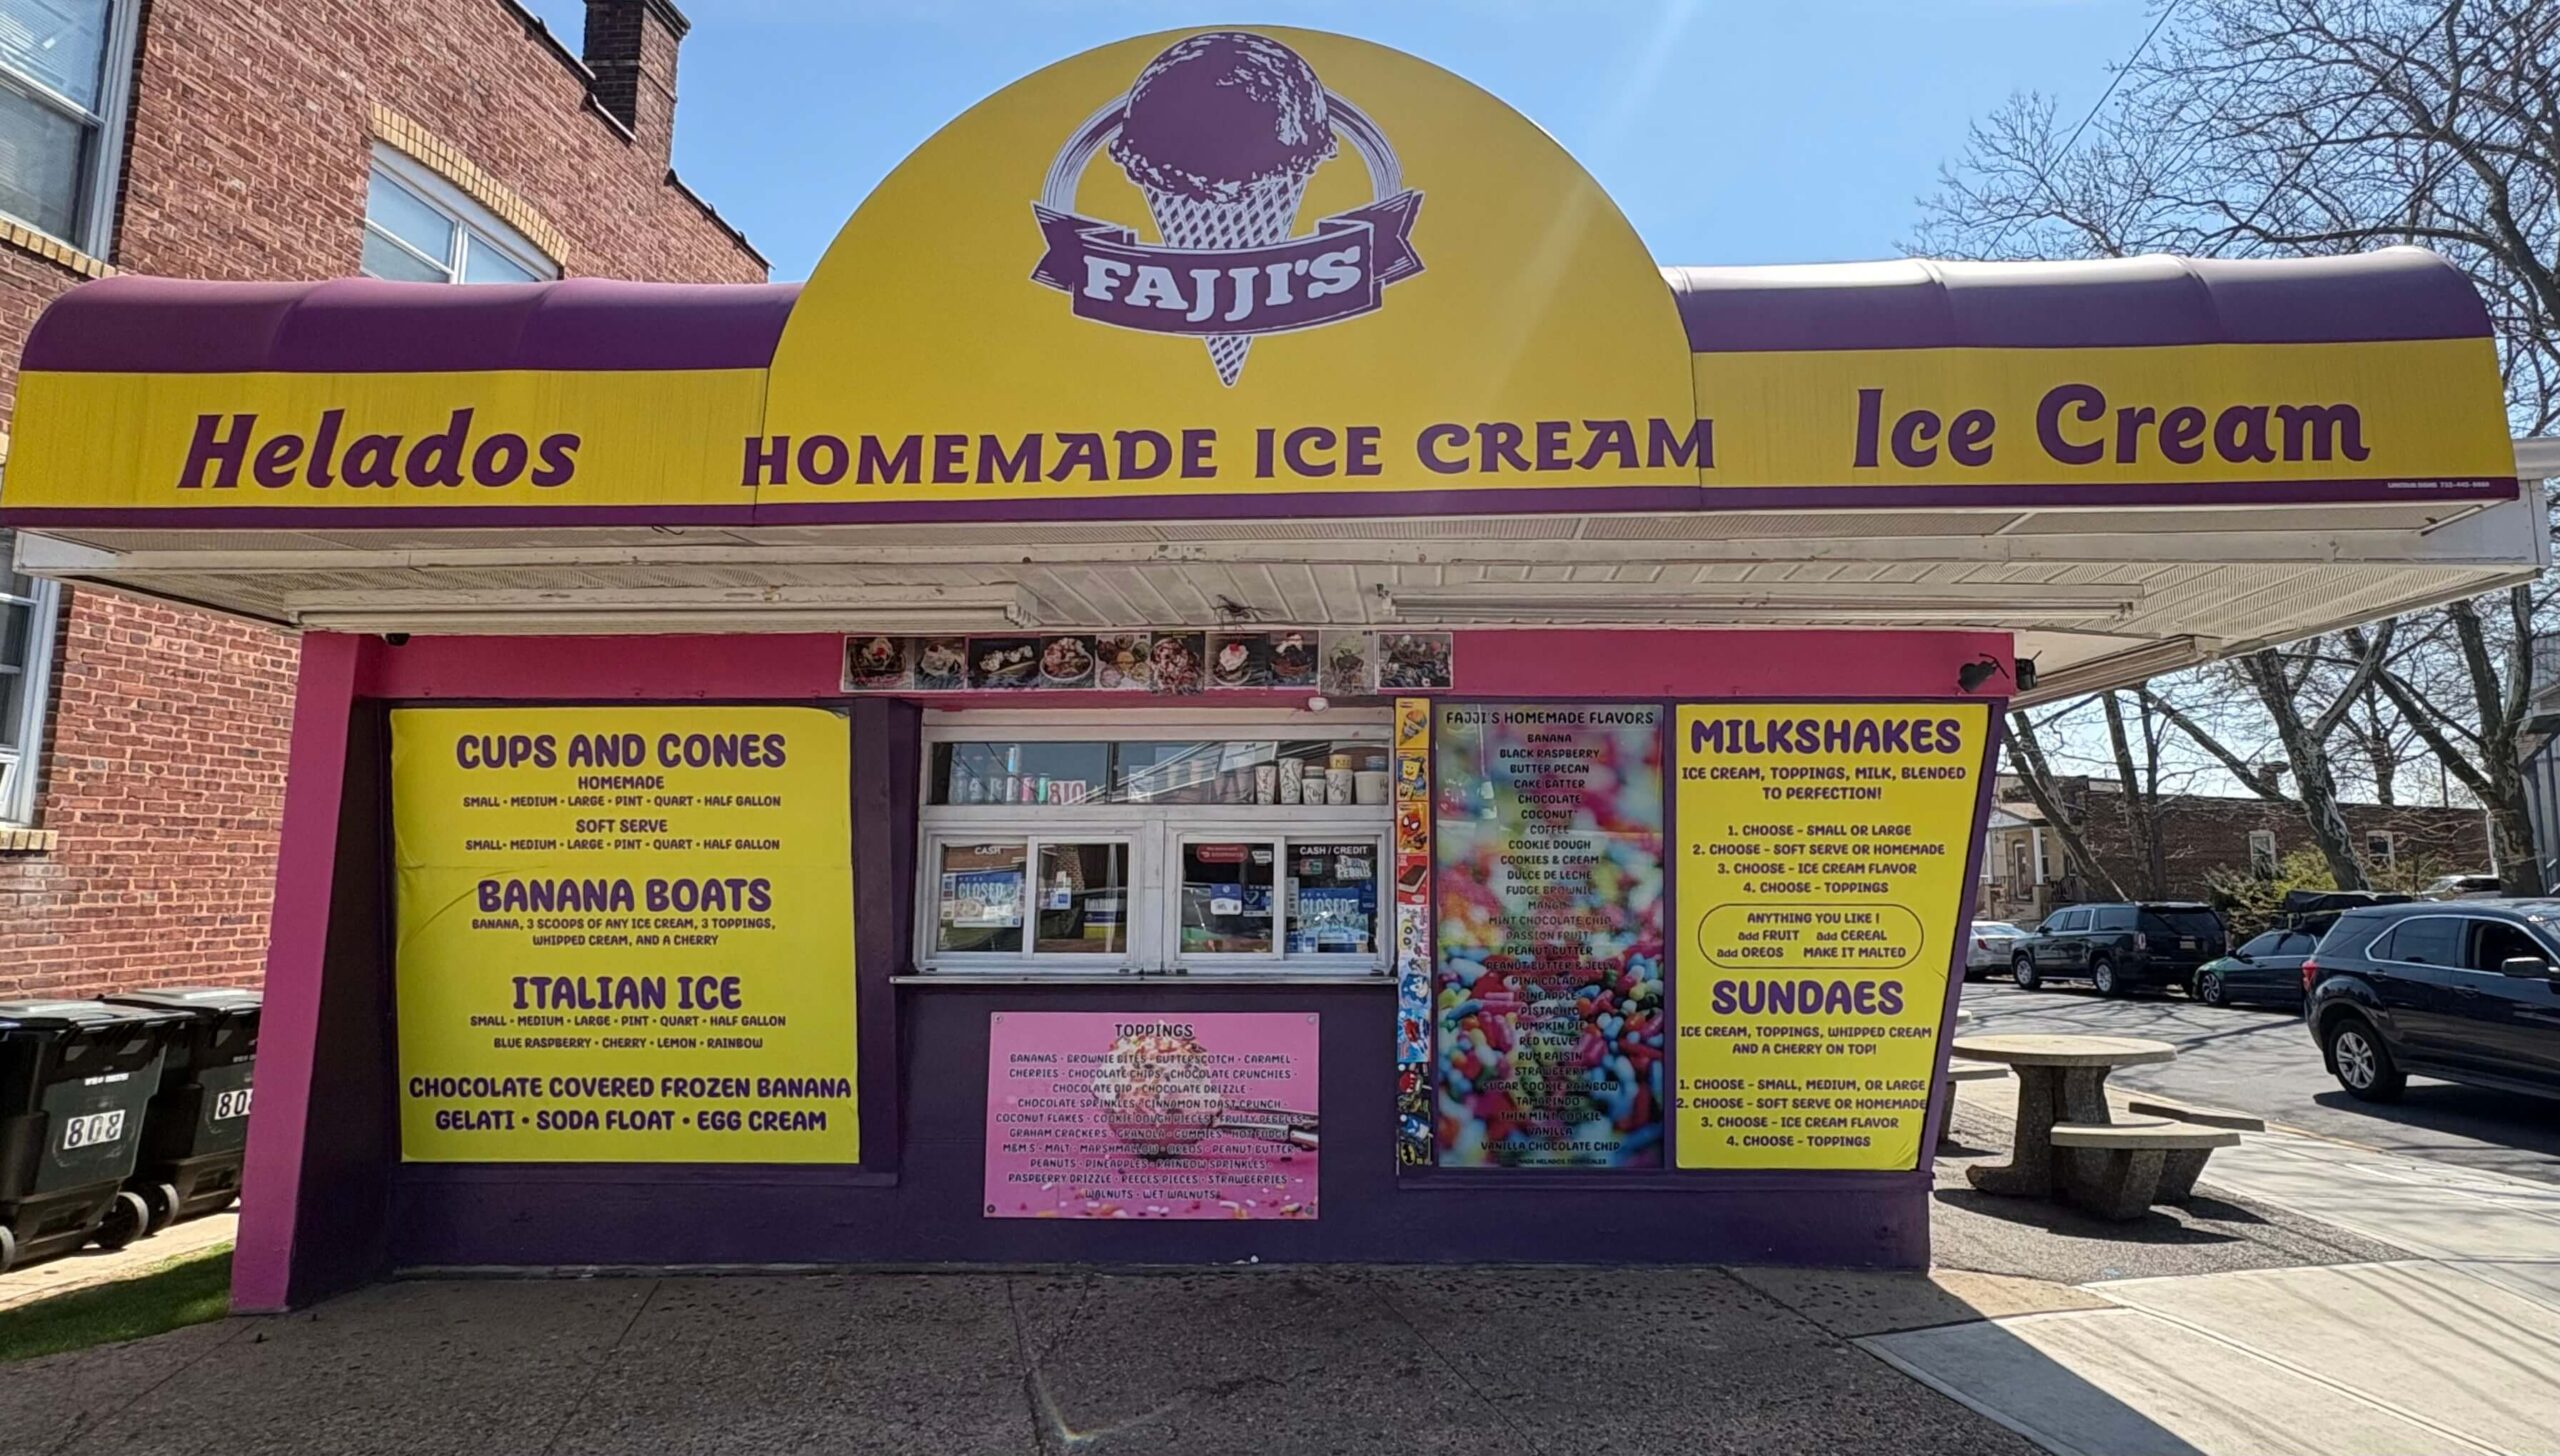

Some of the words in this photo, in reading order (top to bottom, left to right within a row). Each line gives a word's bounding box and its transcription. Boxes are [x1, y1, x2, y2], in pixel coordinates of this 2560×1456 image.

[1083, 246, 1361, 322] FAJJI'S
[1853, 388, 1997, 469] Ice
[2035, 383, 2371, 465] Cream
[177, 407, 582, 488] Helados
[740, 429, 1218, 486] HOMEMADE
[1254, 426, 1383, 478] ICE
[1416, 418, 1716, 474] CREAM
[1446, 712, 1500, 724] FAJJI'S
[1504, 712, 1586, 724] HOMEMADE
[1589, 712, 1653, 724] FLAVORS
[1691, 719, 1961, 753] MILKSHAKES
[456, 733, 556, 769] CUPS
[568, 733, 646, 769] AND
[657, 732, 786, 769] CONES
[1500, 749, 1534, 758] BLACK
[1537, 749, 1599, 758] RASPBERRY
[1510, 764, 1550, 773] BUTTER
[1554, 764, 1589, 773] PECAN
[1682, 767, 1706, 779] ICE
[1710, 767, 1765, 781] CREAM,
[1770, 767, 1850, 781] TOPPINGS,
[1855, 767, 1896, 781] MILK,
[1901, 767, 1965, 779] BLENDED
[578, 776, 664, 790] HOMEMADE
[1514, 779, 1541, 788] CAKE
[1544, 779, 1585, 788] BATTER
[1763, 787, 1781, 799] TO
[1786, 787, 1882, 799] PERFECTION!
[463, 796, 499, 807] SMALL
[510, 796, 557, 807] MEDIUM
[568, 796, 605, 807] LARGE
[615, 796, 642, 807] PINT
[653, 796, 693, 807] QUART
[705, 796, 733, 807] HALF
[735, 796, 781, 807] GALLON
[1518, 795, 1581, 804] CHOCOLATE
[576, 819, 615, 833] SOFT
[619, 819, 668, 833] SERVE
[1728, 825, 1738, 836] 1.
[1743, 825, 1794, 836] CHOOSE
[1807, 825, 1846, 836] SMALL
[1851, 825, 1868, 836] OR
[1871, 825, 1911, 836] LARGE
[1508, 840, 1550, 849] COOKIE
[1553, 840, 1591, 849] DOUGH
[1693, 844, 1705, 854] 2.
[1709, 844, 1760, 854] CHOOSE
[1773, 844, 1806, 854] SOFT
[1809, 844, 1848, 854] SERVE
[1852, 844, 1870, 854] OR
[1874, 844, 1944, 854] HOMEMADE
[974, 847, 1001, 855] CASH
[1300, 846, 1327, 855] CASH
[1334, 846, 1368, 855] CREDIT
[1718, 864, 1730, 874] 3.
[1734, 864, 1785, 874] CHOOSE
[1798, 864, 1819, 874] ICE
[1822, 864, 1865, 874] CREAM
[1868, 864, 1917, 874] FLAVOR
[1507, 871, 1540, 880] DULCE
[1544, 871, 1556, 880] DE
[1559, 871, 1592, 880] LECHE
[958, 882, 1003, 899] CLOSED
[1743, 883, 1756, 893] 4.
[1760, 883, 1811, 893] CHOOSE
[1824, 883, 1888, 893] TOPPINGS
[478, 879, 634, 912] BANANA
[646, 878, 771, 912] BOATS
[1301, 898, 1350, 916] CLOSED
[1747, 913, 1812, 924] ANYTHING
[1815, 913, 1840, 924] YOU
[1845, 913, 1872, 924] LIKE
[472, 919, 523, 931] BANANA,
[527, 919, 534, 929] 3
[537, 919, 584, 929] SCOOPS
[587, 919, 602, 929] OF
[605, 919, 628, 929] ANY
[632, 919, 651, 929] ICE
[653, 919, 698, 931] CREAM,
[701, 919, 709, 929] 3
[712, 919, 775, 931] TOPPINGS,
[1738, 931, 1759, 941] add
[1763, 931, 1799, 941] FRUIT
[1816, 931, 1837, 941] add
[1841, 931, 1887, 941] CEREAL
[1717, 948, 1738, 958] add
[1741, 948, 1784, 958] OREOS
[1803, 948, 1838, 958] MAKE
[1842, 948, 1855, 958] IT
[1859, 948, 1906, 958] MALTED
[512, 976, 666, 1009] ITALIAN
[678, 976, 741, 1009] ICE
[1712, 980, 1904, 1015] SUNDAES
[470, 1016, 507, 1027] SMALL
[517, 1016, 564, 1027] MEDIUM
[574, 1016, 610, 1027] LARGE
[621, 1016, 648, 1027] PINT
[660, 1016, 699, 1027] QUART
[710, 1016, 738, 1027] HALF
[741, 1016, 786, 1027] GALLON
[1115, 1024, 1193, 1037] TOPPINGS
[1681, 1026, 1701, 1038] ICE
[1704, 1026, 1751, 1039] CREAM,
[1756, 1026, 1823, 1039] TOPPINGS,
[1828, 1026, 1885, 1038] WHIPPED
[1889, 1026, 1931, 1038] CREAM
[494, 1038, 521, 1049] BLUE
[525, 1038, 591, 1049] RASPBERRY
[602, 1038, 646, 1049] CHERRY
[657, 1038, 696, 1049] LEMON
[707, 1038, 763, 1049] RAINBOW
[1733, 1044, 1758, 1054] AND
[1762, 1044, 1770, 1054] A
[1773, 1044, 1822, 1054] CHERRY
[1826, 1044, 1844, 1054] ON
[1848, 1044, 1876, 1054] TOP!
[1010, 1055, 1058, 1064] BANANAS
[1067, 1055, 1114, 1064] BROWNIE
[1117, 1055, 1147, 1064] BITES
[1156, 1055, 1235, 1064] BUTTERSCOTCH
[1244, 1055, 1291, 1064] CARAMEL
[1518, 1052, 1544, 1061] RUM
[1547, 1052, 1582, 1061] RAISIN
[1009, 1069, 1059, 1079] CHERRIES
[1068, 1069, 1128, 1079] CHOCOLATE
[1130, 1069, 1161, 1079] CHIPS
[1170, 1069, 1230, 1079] CHOCOLATE
[1233, 1069, 1291, 1079] CRUNCHIES
[409, 1077, 543, 1098] CHOCOLATE
[549, 1077, 654, 1098] COVERED
[661, 1077, 750, 1098] FROZEN
[757, 1077, 851, 1098] BANANA
[218, 1090, 254, 1118] 80
[435, 1110, 515, 1130] GELATI
[537, 1110, 599, 1130] SODA
[605, 1110, 674, 1130] FLOAT
[697, 1110, 741, 1130] EGG
[749, 1110, 826, 1130] CREAM
[67, 1112, 121, 1147] 808
[1481, 1141, 1525, 1150] VANILLA
[1528, 1141, 1591, 1150] CHOCOLATE
[1594, 1141, 1620, 1150] CHIP
[1726, 1136, 1739, 1146] 4.
[1743, 1136, 1794, 1146] CHOOSE
[1807, 1136, 1870, 1146] TOPPINGS
[1085, 1189, 1133, 1199] WALNUTS
[1143, 1189, 1164, 1199] WET
[1167, 1189, 1216, 1199] WALNUTS
